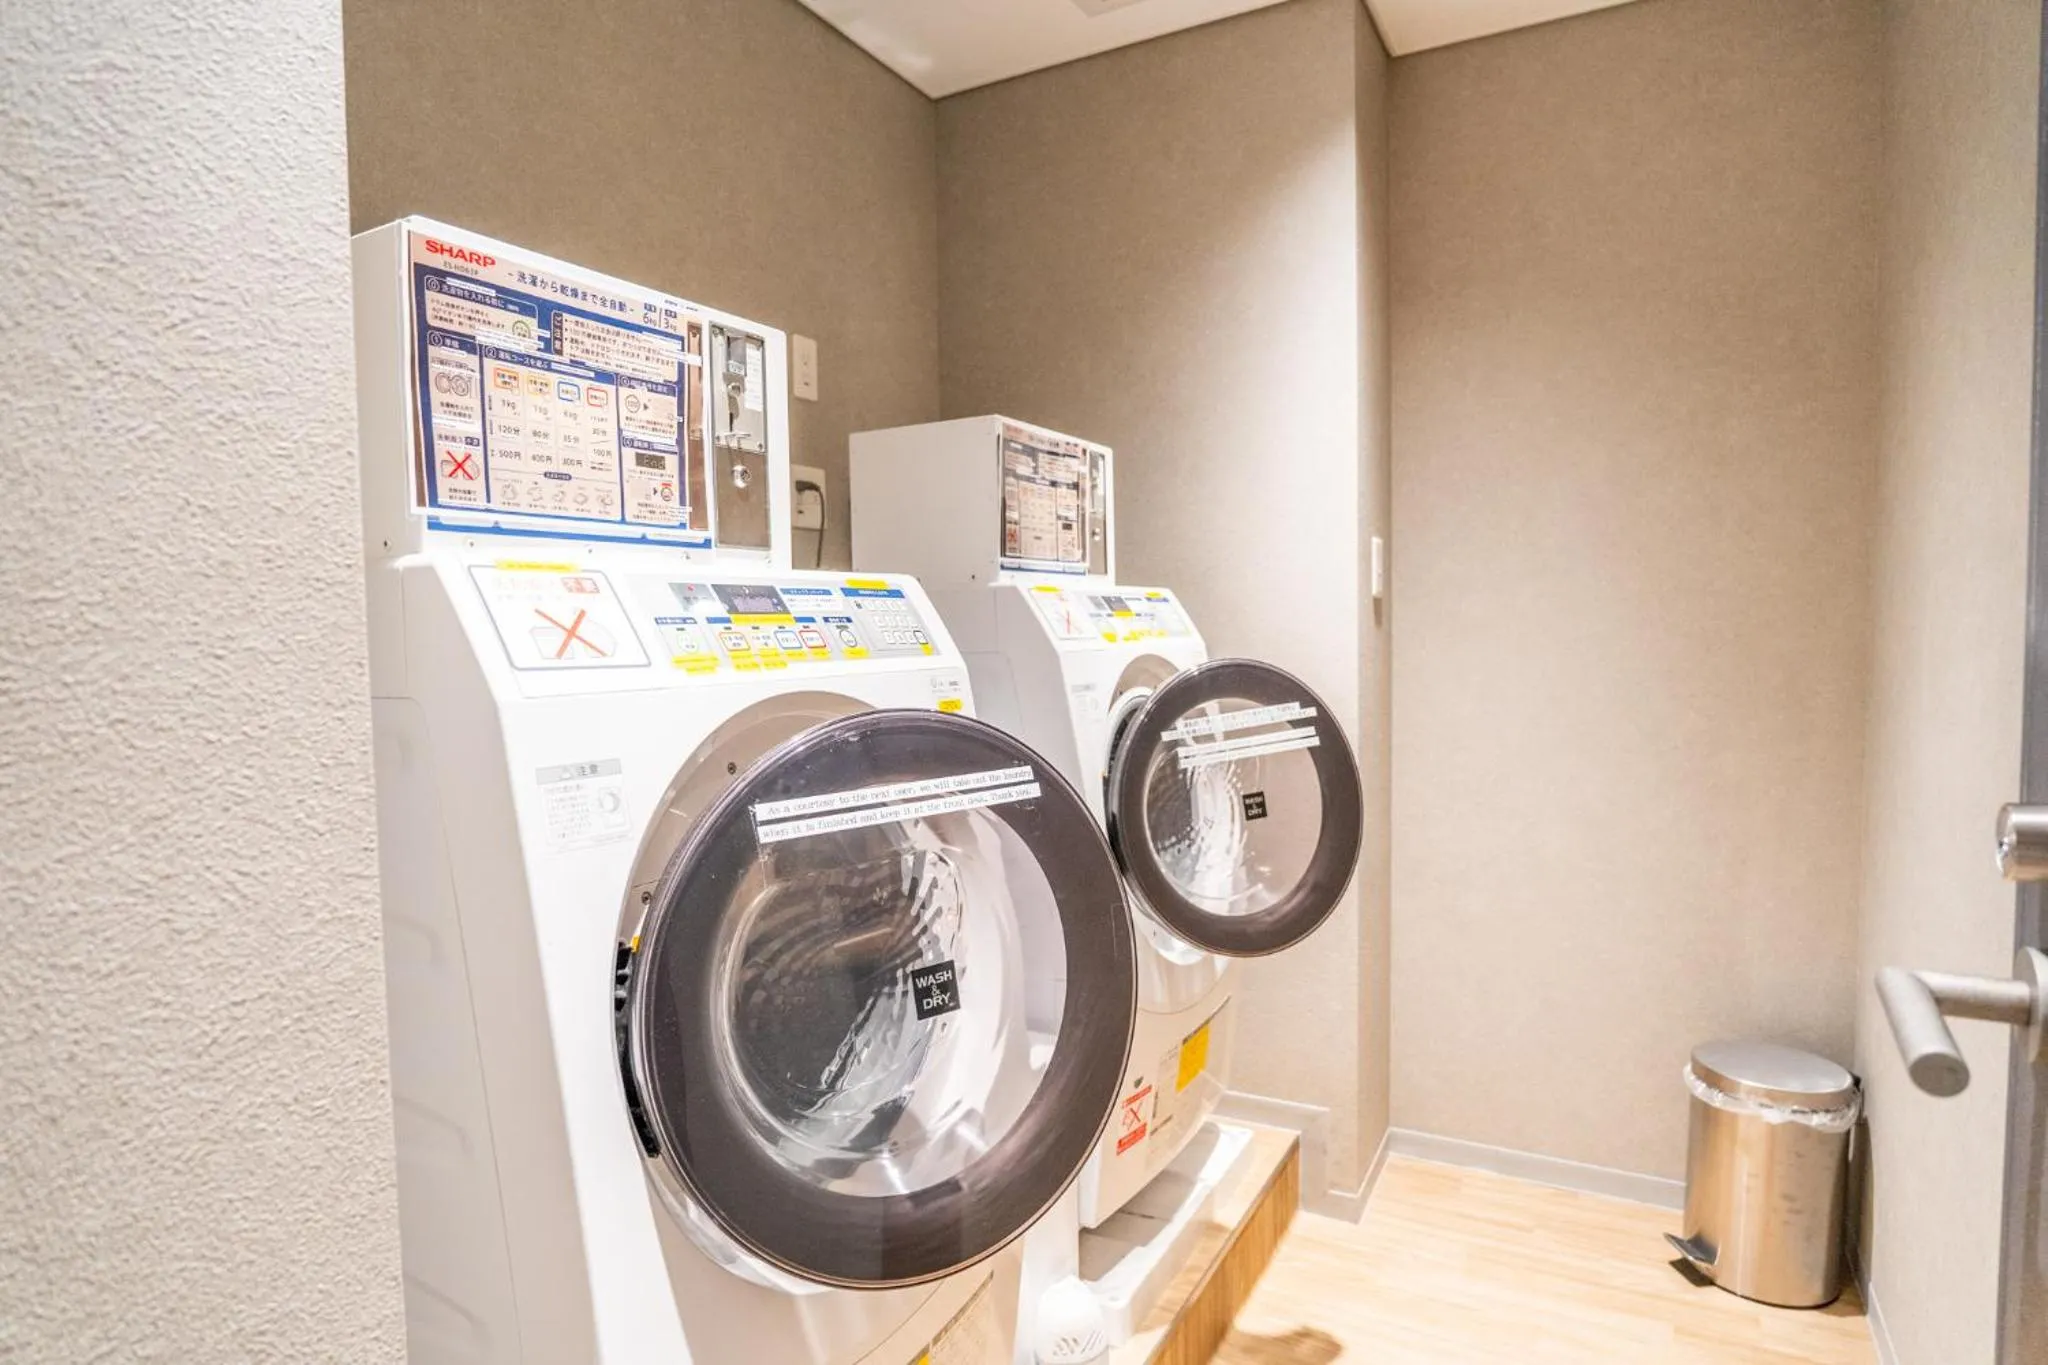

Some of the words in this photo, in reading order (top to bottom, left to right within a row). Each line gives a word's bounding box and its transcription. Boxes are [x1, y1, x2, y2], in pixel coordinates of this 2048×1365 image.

[425, 239, 496, 267] SHARP
[915, 969, 952, 988] WASH
[931, 985, 941, 995] &
[923, 992, 951, 1010] DRY
